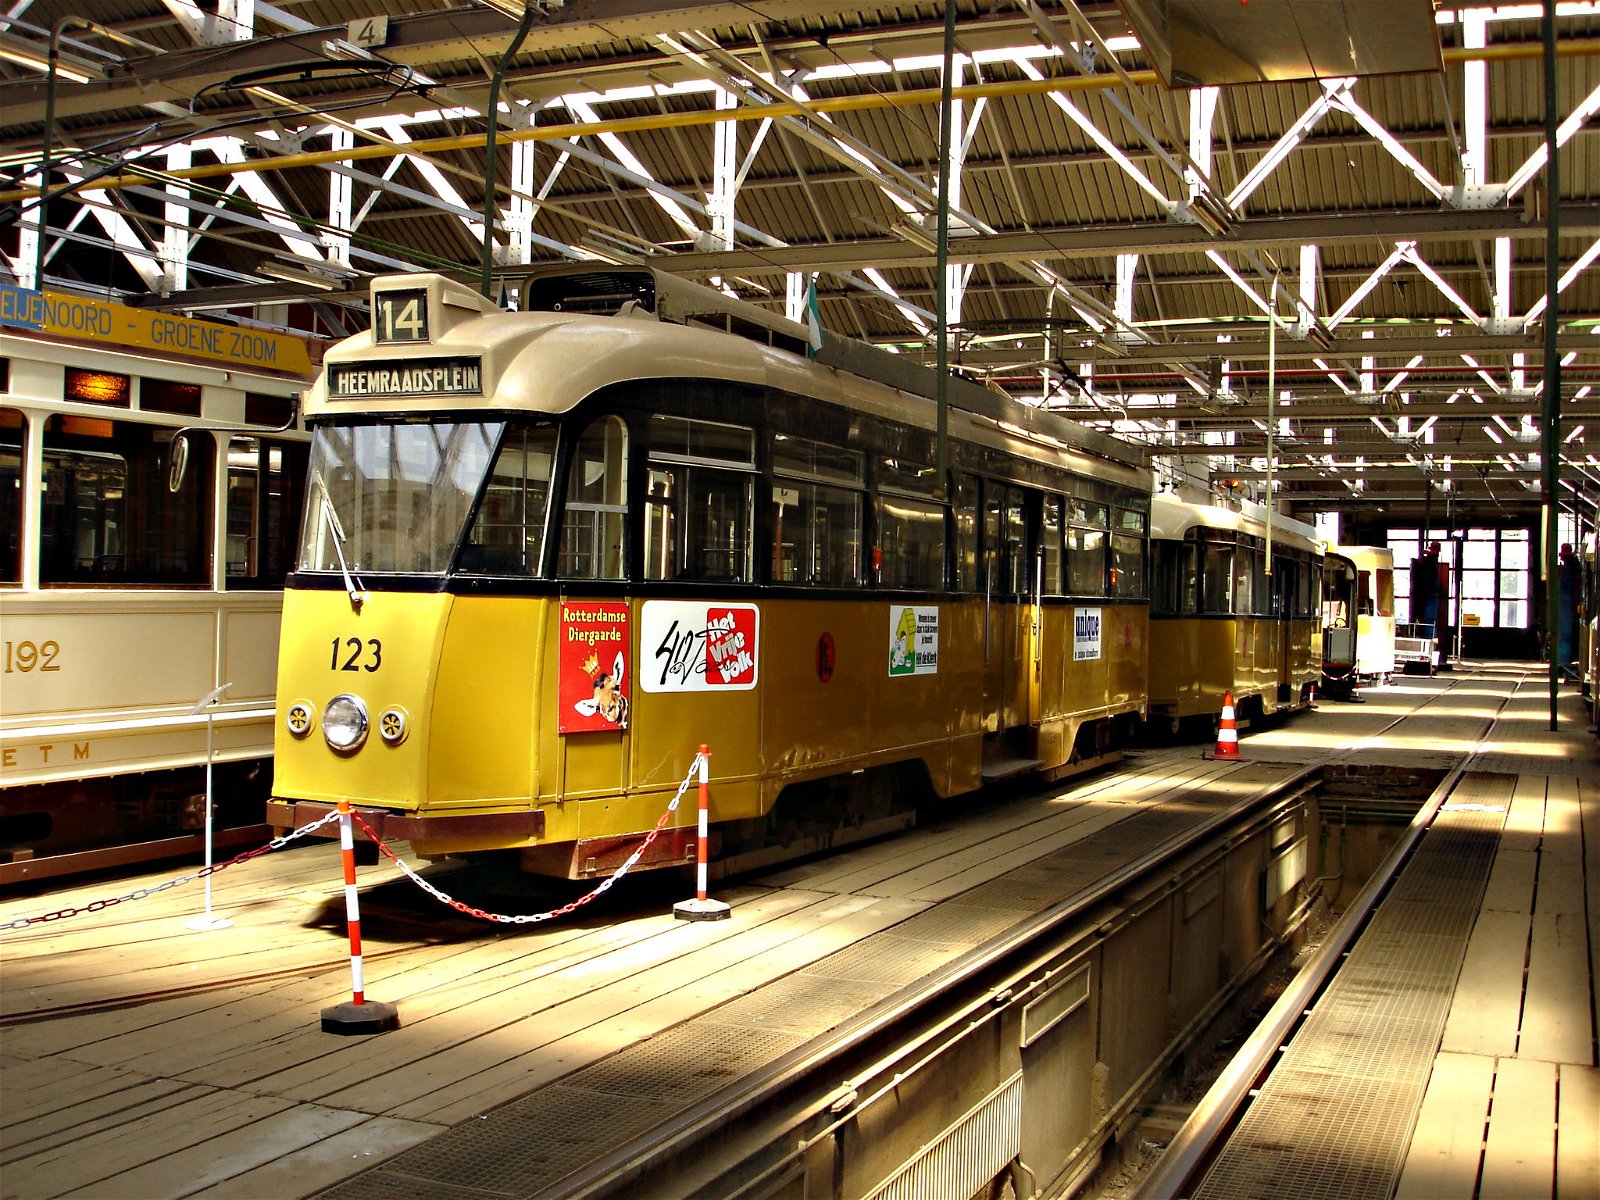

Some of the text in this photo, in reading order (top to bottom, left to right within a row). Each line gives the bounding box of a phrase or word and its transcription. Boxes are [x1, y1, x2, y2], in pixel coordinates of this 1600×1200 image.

[358, 19, 375, 43] 4
[382, 298, 423, 340] 14
[151, 317, 225, 355] GROENE
[230, 332, 278, 364] ZOOM
[337, 365, 480, 395] HEEMRAADSPLEIN
[563, 607, 626, 623] Rotterdamse
[707, 611, 736, 642] Het
[1075, 609, 1099, 641] unique
[568, 626, 621, 646] Diergaarde
[709, 632, 745, 662] Vrije
[5, 640, 61, 673] 192
[330, 636, 382, 673] 123
[719, 650, 753, 683] Volk
